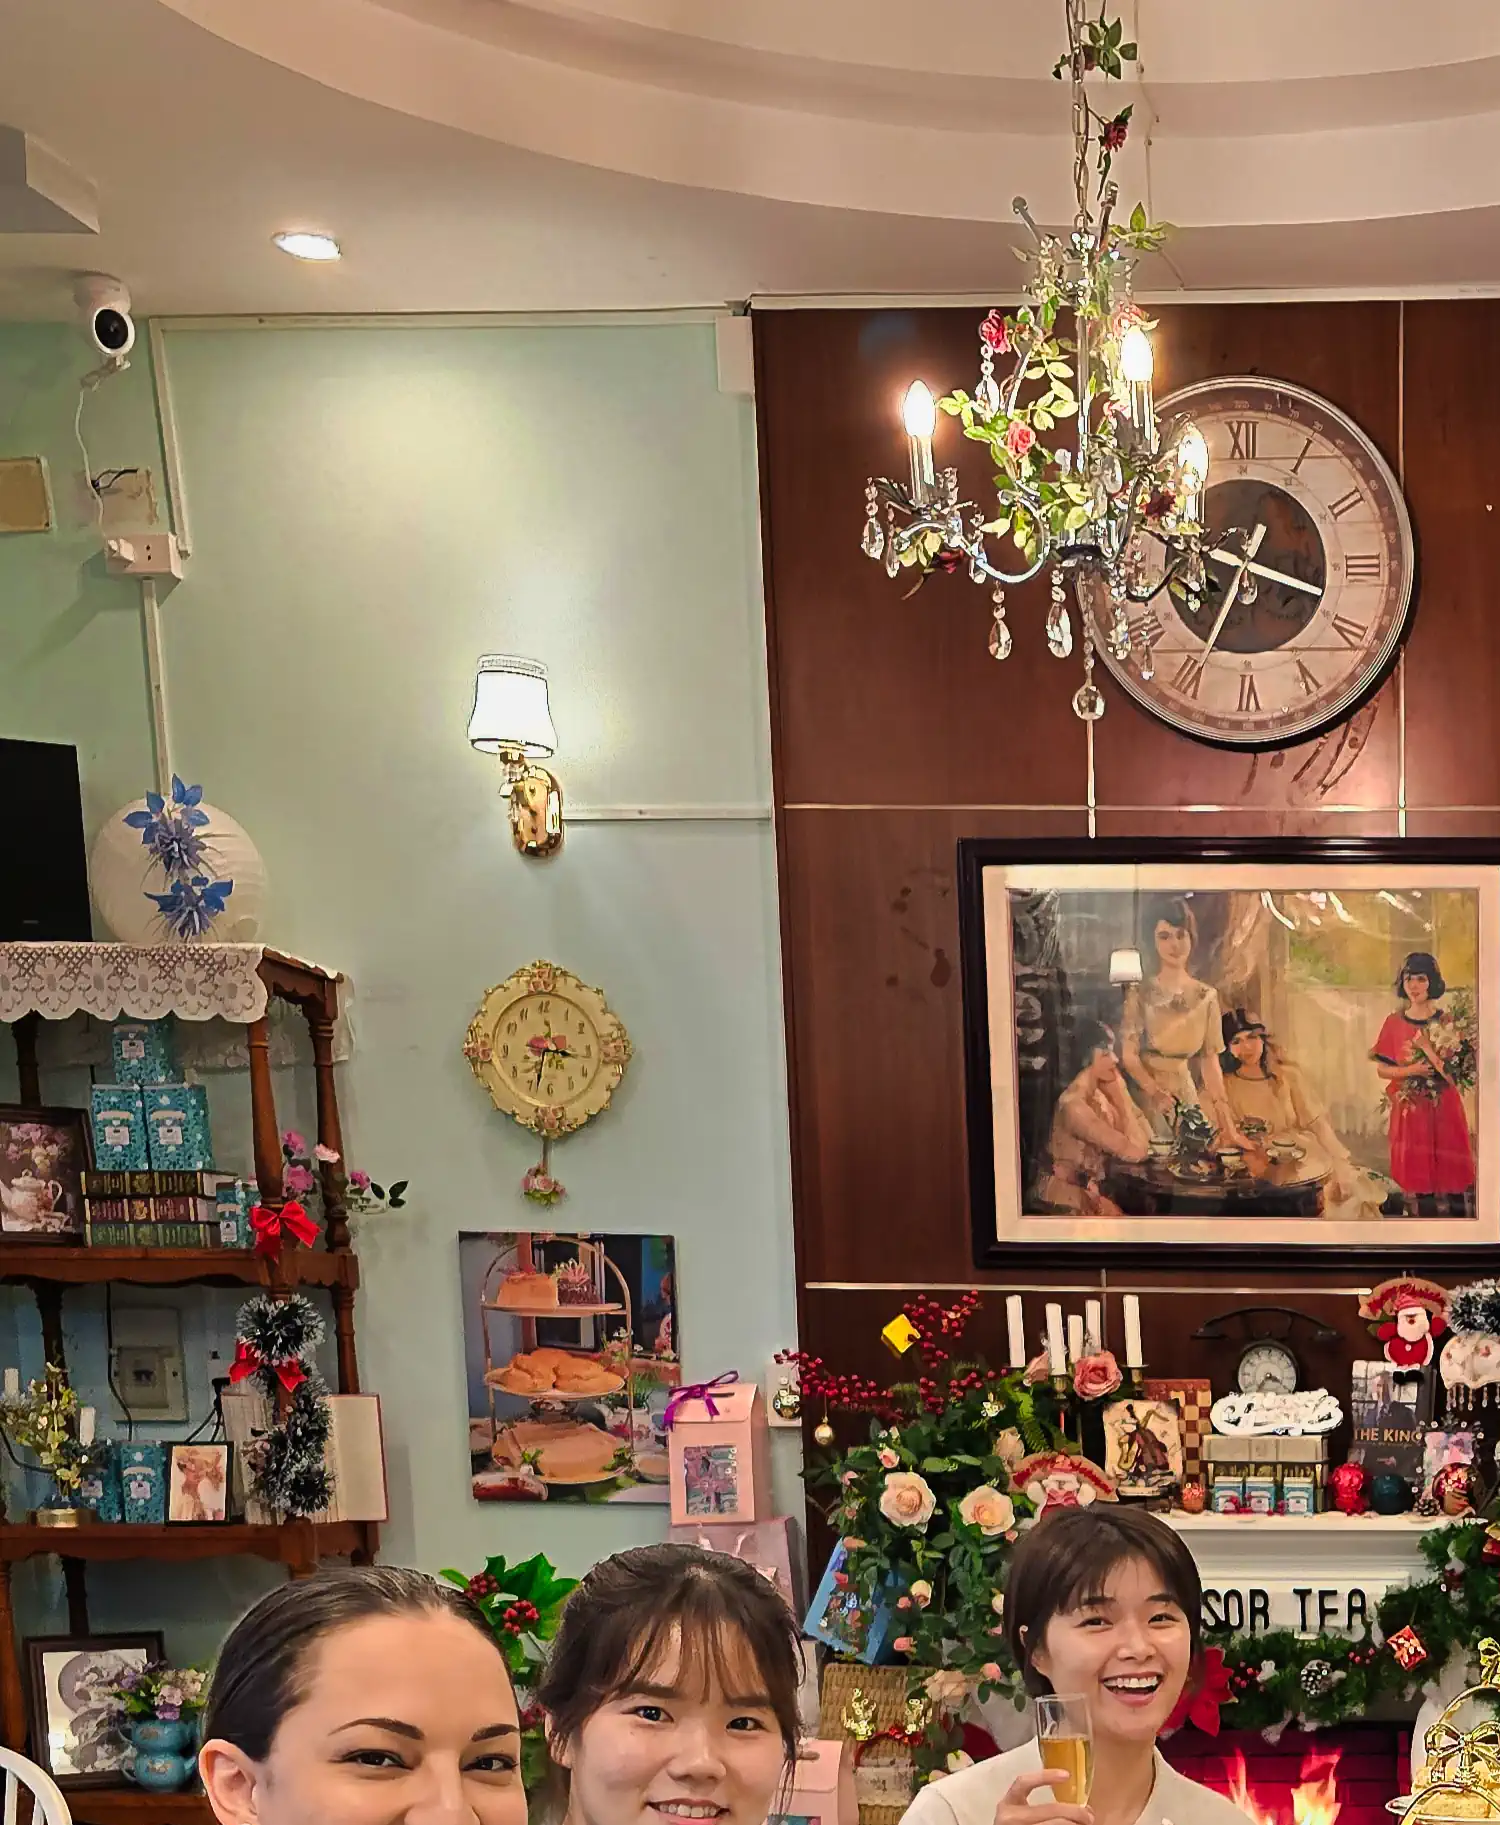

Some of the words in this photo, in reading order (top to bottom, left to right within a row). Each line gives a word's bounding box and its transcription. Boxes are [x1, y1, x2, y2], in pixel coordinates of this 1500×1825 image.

[1224, 420, 1259, 459] XII
[1289, 438, 1313, 474] I
[1328, 487, 1365, 520] II
[1345, 553, 1381, 578] III
[1332, 614, 1369, 651] IV
[1237, 673, 1262, 712] VI
[1296, 658, 1323, 696] V
[1354, 1428, 1378, 1441] THE
